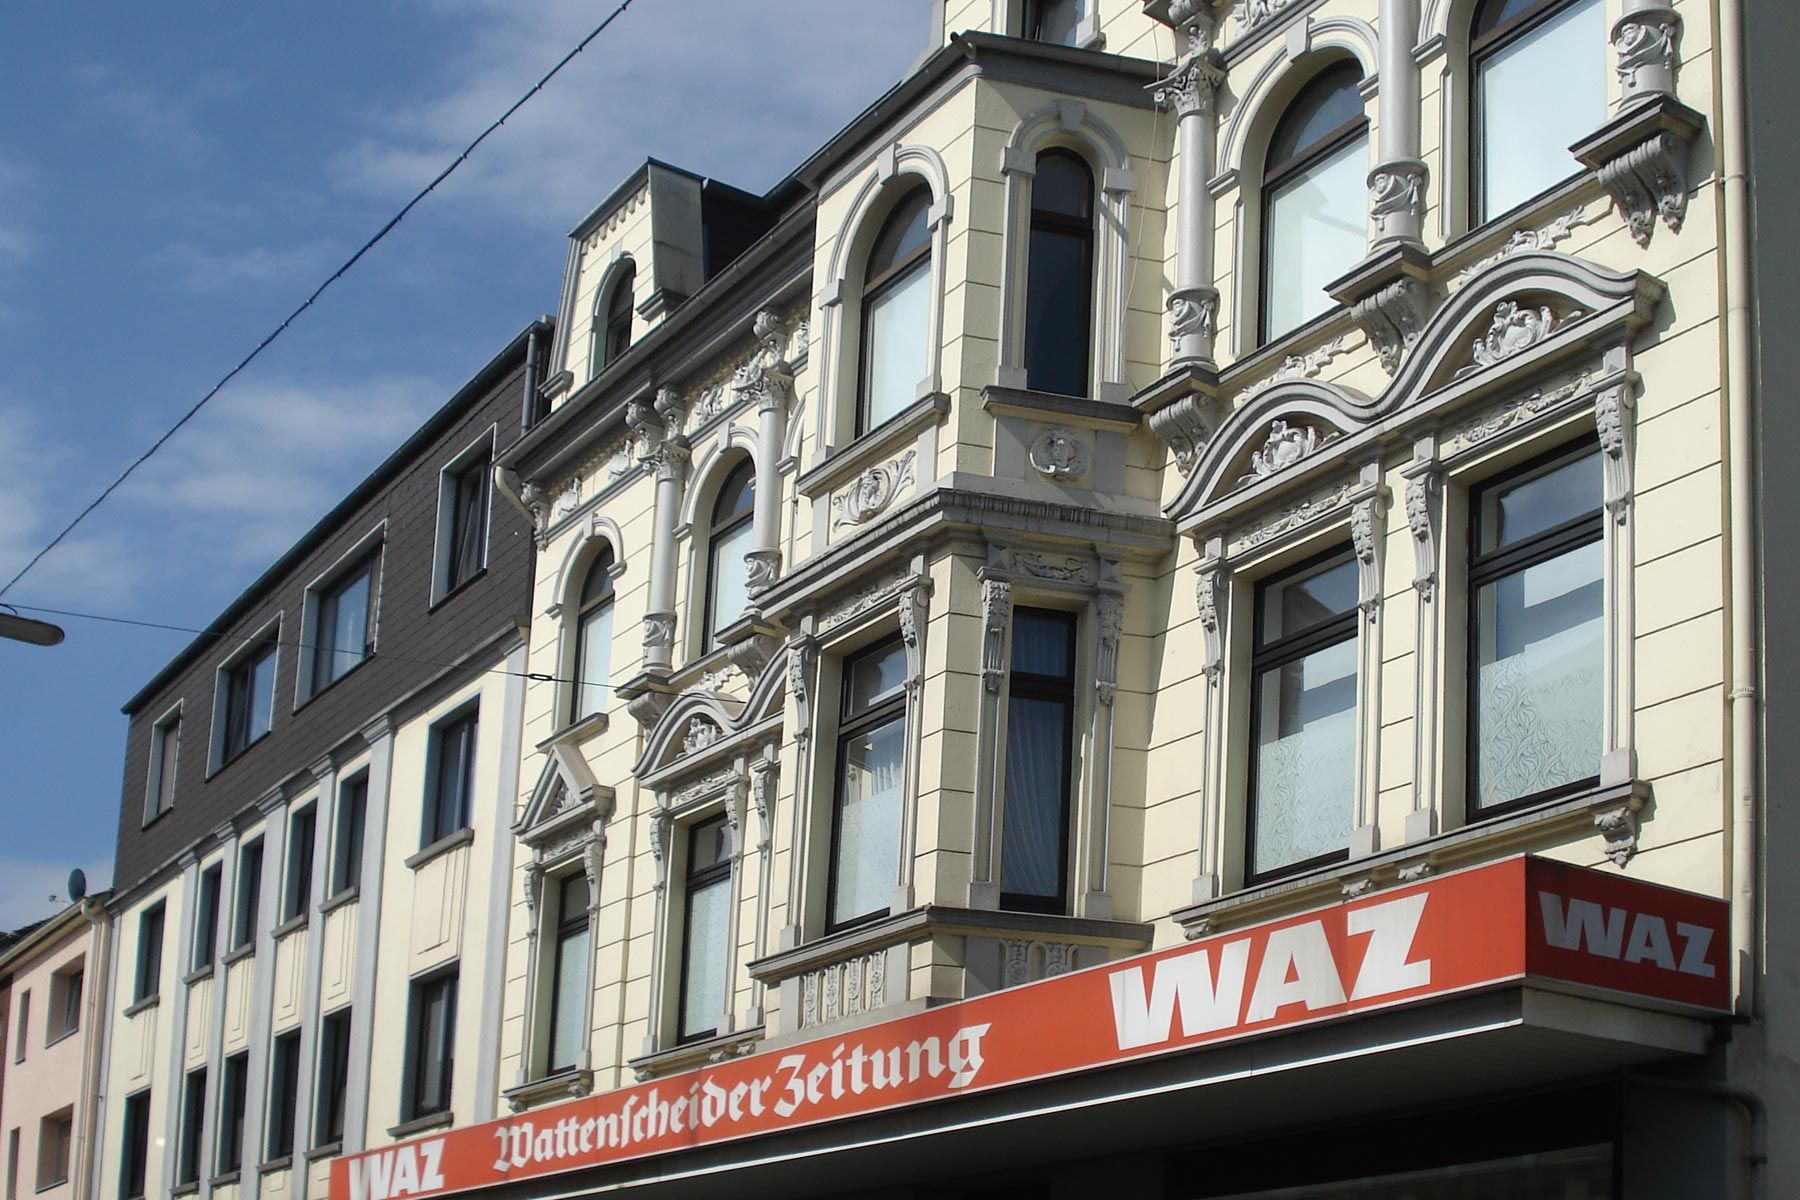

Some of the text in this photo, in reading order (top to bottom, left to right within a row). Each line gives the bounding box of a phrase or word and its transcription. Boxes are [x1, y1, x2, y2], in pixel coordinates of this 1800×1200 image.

[1109, 892, 1431, 1050] WAZ
[1538, 891, 1716, 978] WAZ
[775, 1023, 990, 1118] Zeitung
[348, 1139, 446, 1200] WAZ
